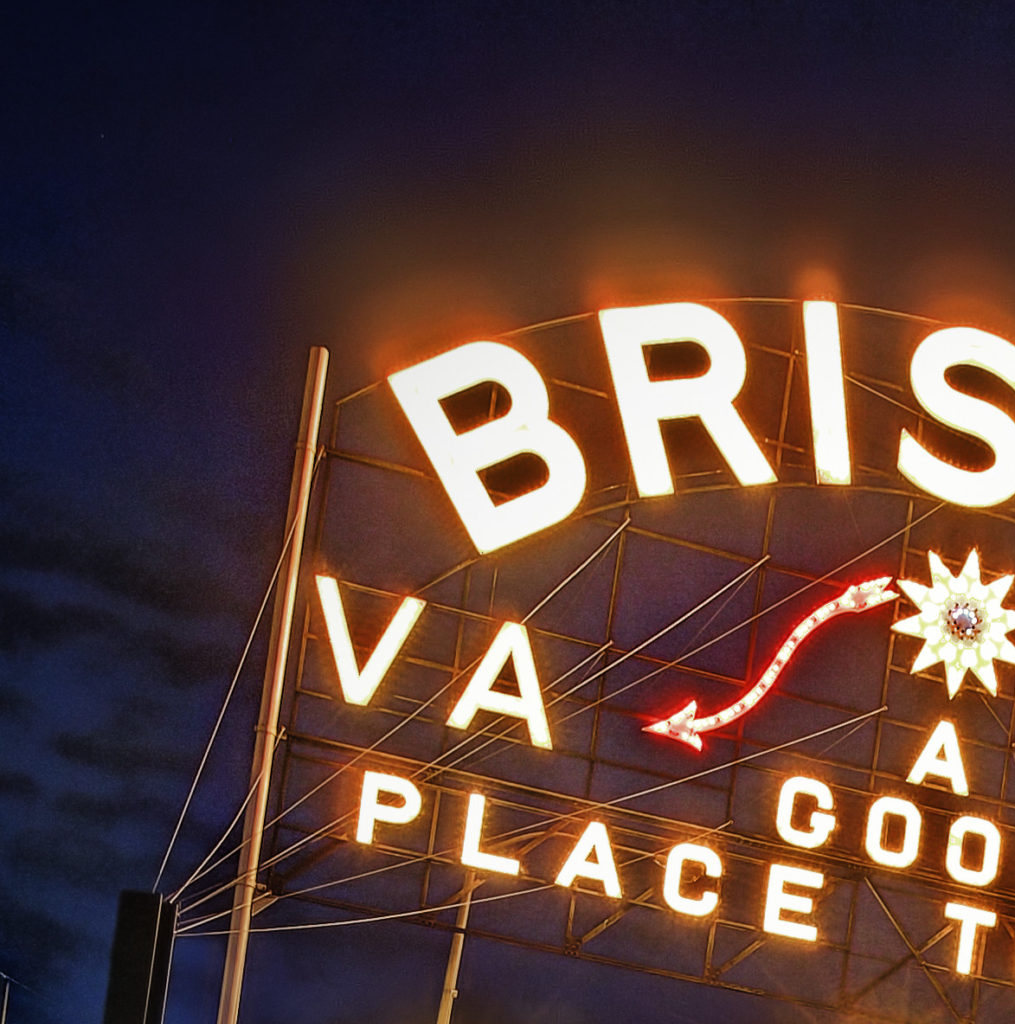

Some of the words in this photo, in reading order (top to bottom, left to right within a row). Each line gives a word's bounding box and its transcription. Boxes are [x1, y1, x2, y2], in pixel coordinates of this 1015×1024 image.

[315, 574, 553, 750] VA
[906, 720, 970, 797] A
[355, 770, 825, 942] PLACE
